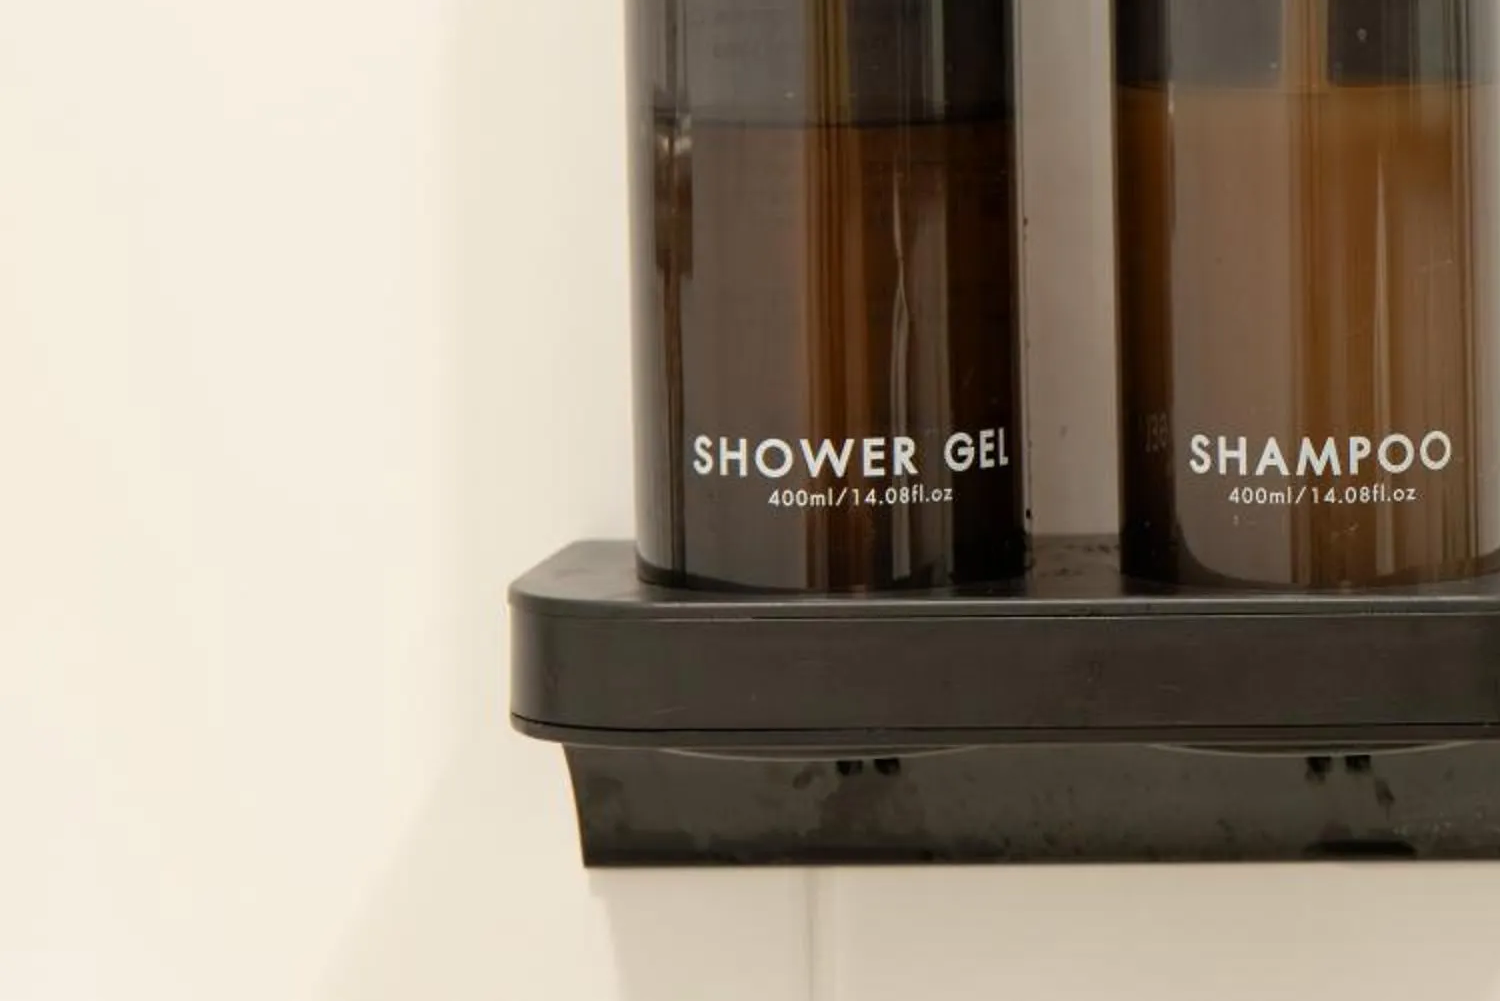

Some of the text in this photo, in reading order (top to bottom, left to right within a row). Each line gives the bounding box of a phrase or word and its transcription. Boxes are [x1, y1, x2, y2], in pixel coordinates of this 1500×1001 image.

[693, 427, 1009, 478] SHOWER GEL
[1189, 430, 1452, 476] SHAMPOO
[767, 484, 953, 507] 400ml/14.08fl.oz
[1228, 483, 1417, 504] 400ml/14.08fl.oz
